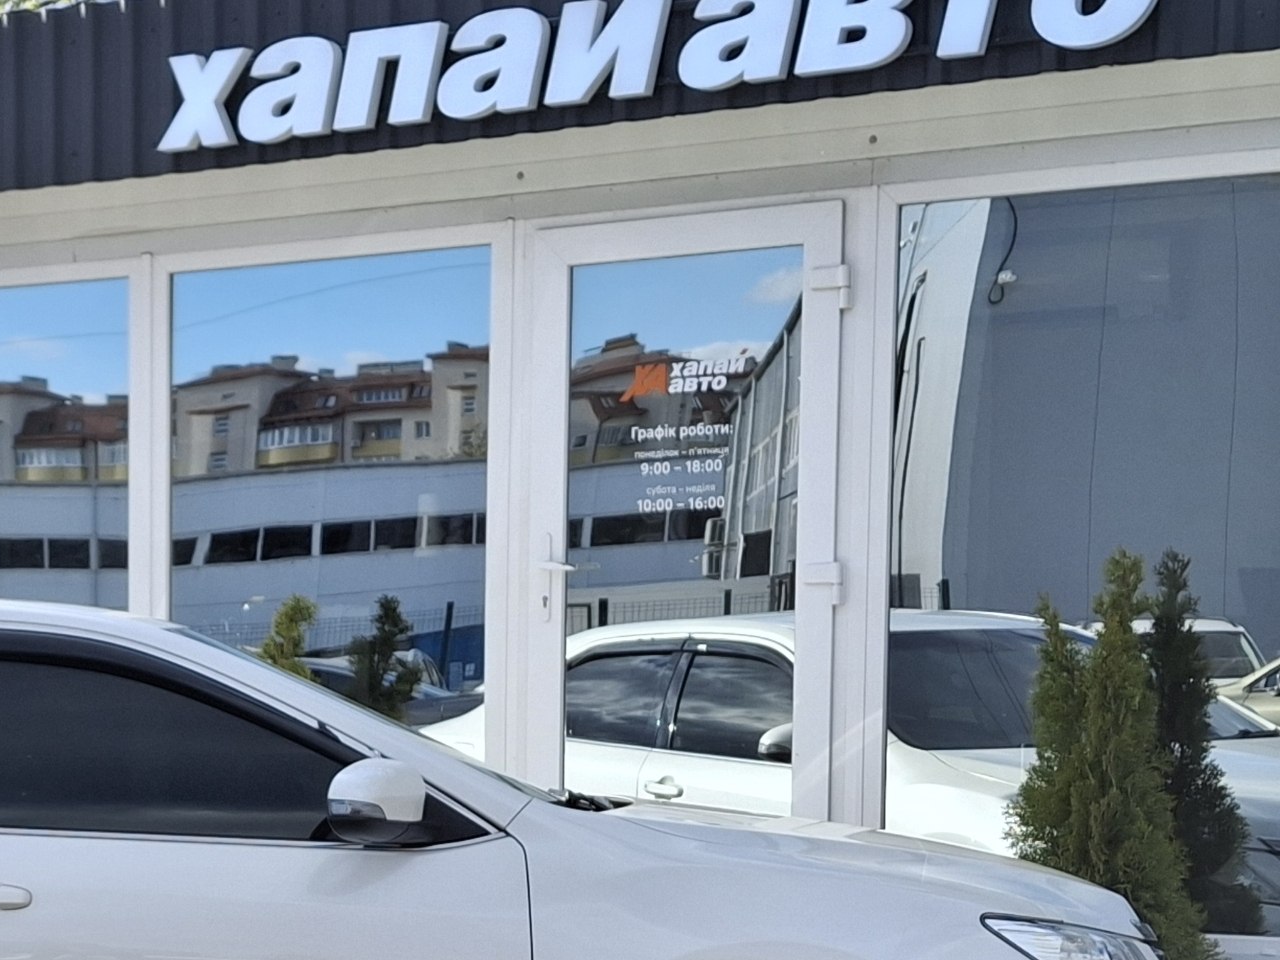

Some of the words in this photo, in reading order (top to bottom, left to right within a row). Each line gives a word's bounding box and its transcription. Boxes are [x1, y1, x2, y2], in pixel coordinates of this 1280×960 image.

[669, 349, 747, 378] хапай
[668, 375, 728, 394] авто
[631, 424, 677, 443] Графік
[680, 422, 734, 440] роботи:
[640, 461, 671, 476] 9:00
[685, 459, 723, 474] 18:00
[646, 485, 677, 496] субота
[686, 482, 716, 494] неділя
[637, 498, 673, 513] 10:00
[688, 496, 725, 511] 16:00
